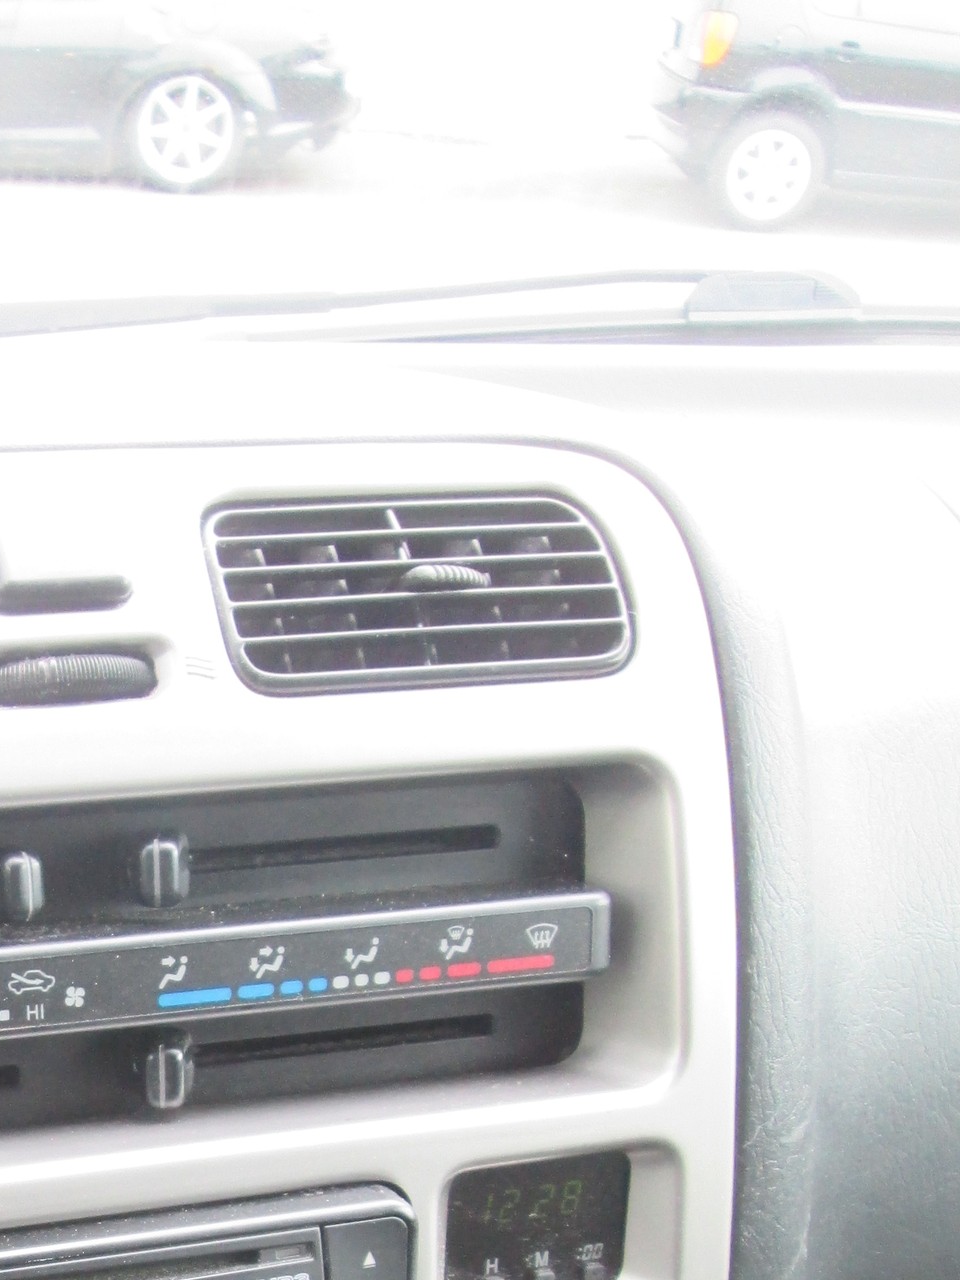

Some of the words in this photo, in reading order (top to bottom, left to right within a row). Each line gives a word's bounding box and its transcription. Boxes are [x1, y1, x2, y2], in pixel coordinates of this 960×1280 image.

[26, 1003, 45, 1020] HI
[486, 1258, 498, 1274] H
[535, 1251, 549, 1267] M
